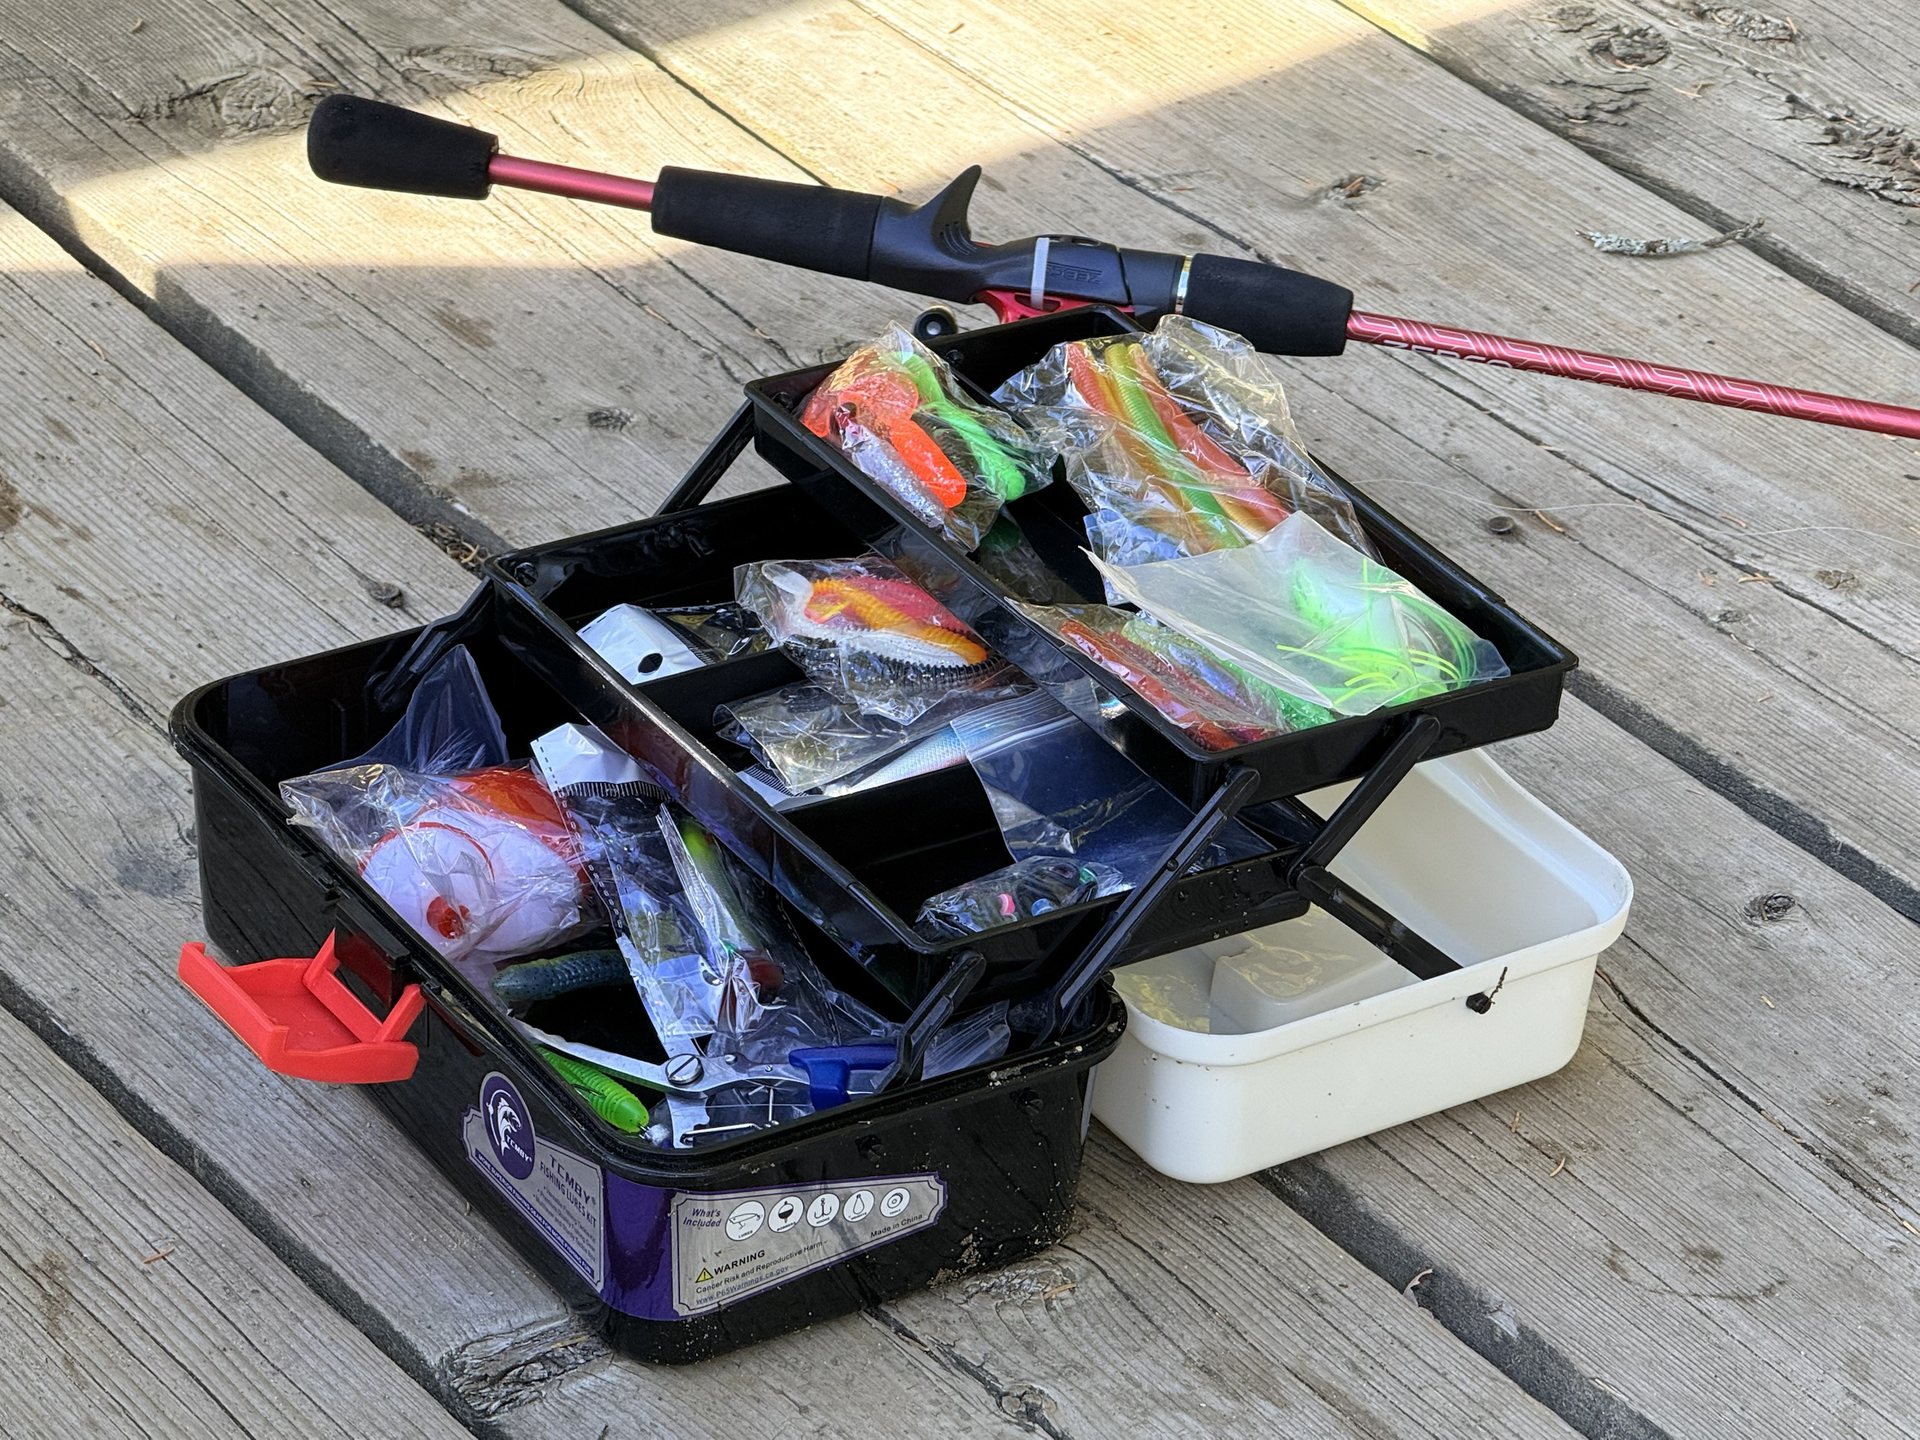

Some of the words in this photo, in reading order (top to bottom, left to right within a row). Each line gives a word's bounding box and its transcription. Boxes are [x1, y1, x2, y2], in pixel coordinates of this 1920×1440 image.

[1046, 266, 1104, 285] ZEBC
[540, 1160, 566, 1195] FISHING
[566, 1187, 586, 1217] LURES
[586, 1210, 597, 1228] KIT
[683, 1217, 722, 1229] Included
[691, 1206, 721, 1218] What's
[870, 1226, 891, 1238] Made
[901, 1214, 923, 1226] China
[696, 1281, 724, 1294] Cancer
[724, 1274, 740, 1285] Risk
[741, 1268, 755, 1280] and
[756, 1249, 803, 1273] Reproductive
[803, 1241, 824, 1254] Harm
[713, 1249, 766, 1276] WARNING
[696, 1264, 789, 1306] www.P65Warnings.ca.gov
